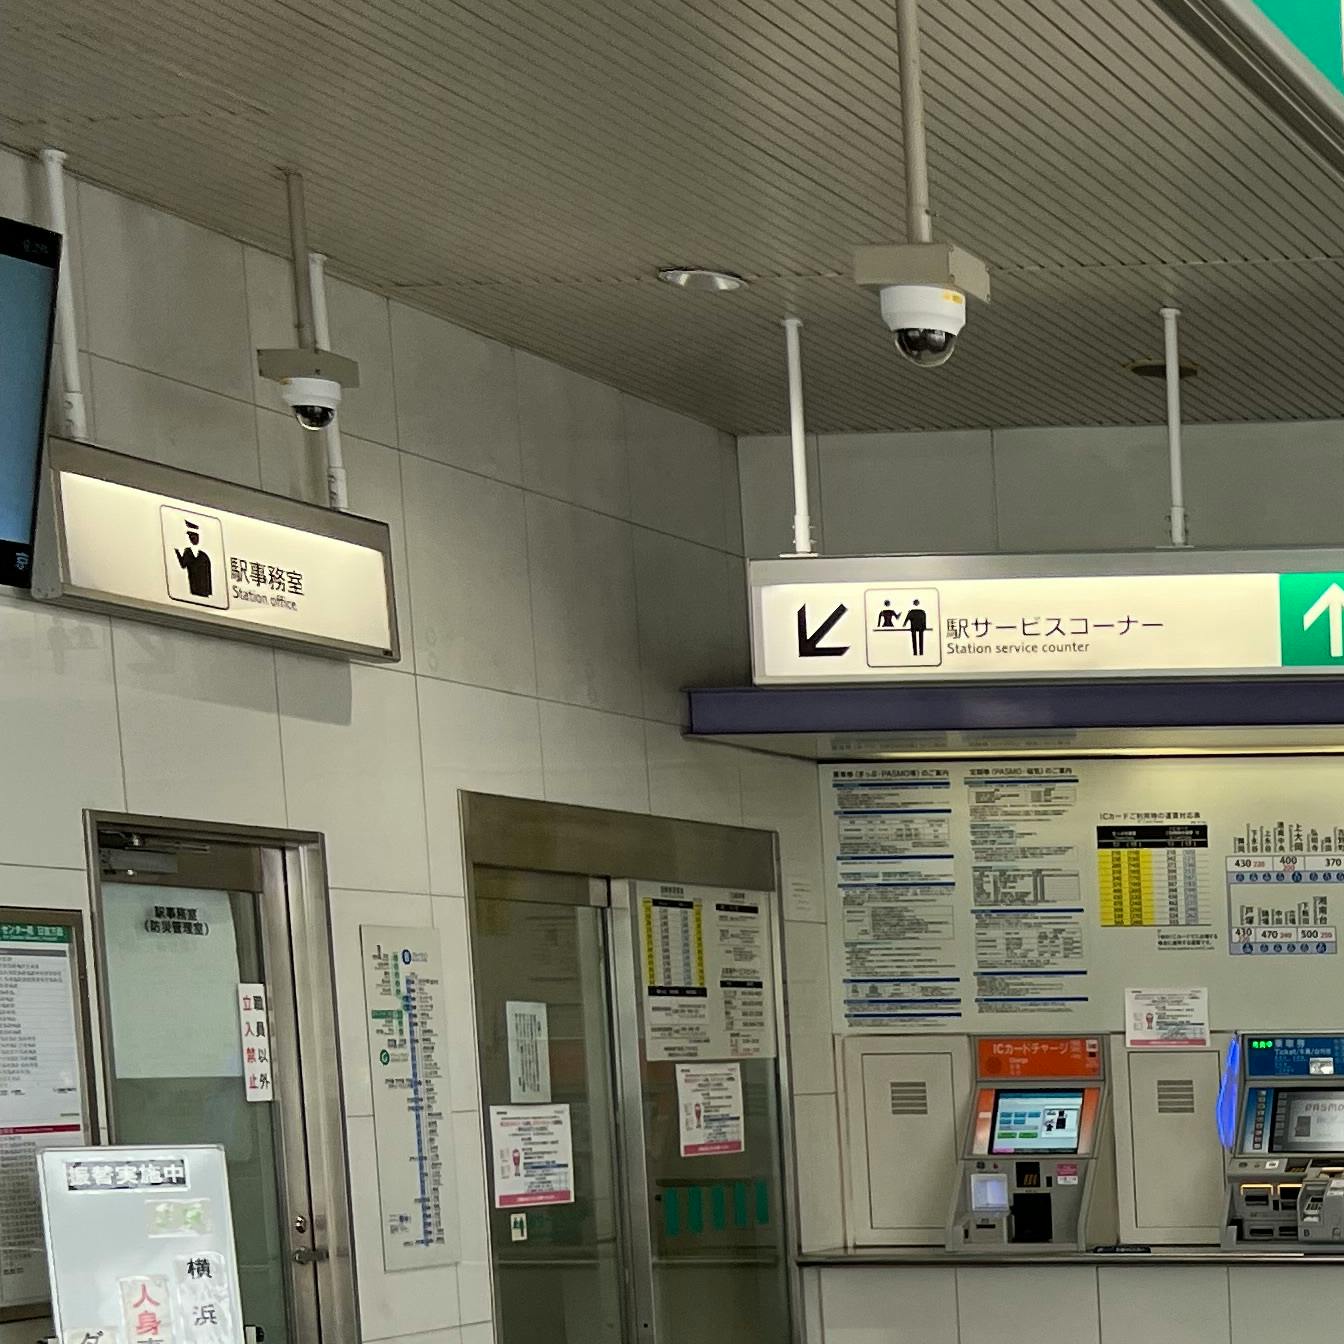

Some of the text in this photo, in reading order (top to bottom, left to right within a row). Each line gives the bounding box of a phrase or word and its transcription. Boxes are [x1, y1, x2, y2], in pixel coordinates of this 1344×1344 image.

[230, 557, 304, 595] 駅事務室
[232, 585, 298, 611] Station office
[947, 616, 1163, 640] 駅サービスコーナー
[947, 642, 1090, 655] Station service counter
[1235, 859, 1251, 868] 430
[1280, 856, 1298, 865] 400
[1325, 858, 1342, 867] 370
[1261, 930, 1278, 939] 470
[1301, 930, 1318, 938] 500
[243, 995, 258, 1089] 立入禁止
[993, 1042, 1069, 1056] ICカードチャージ
